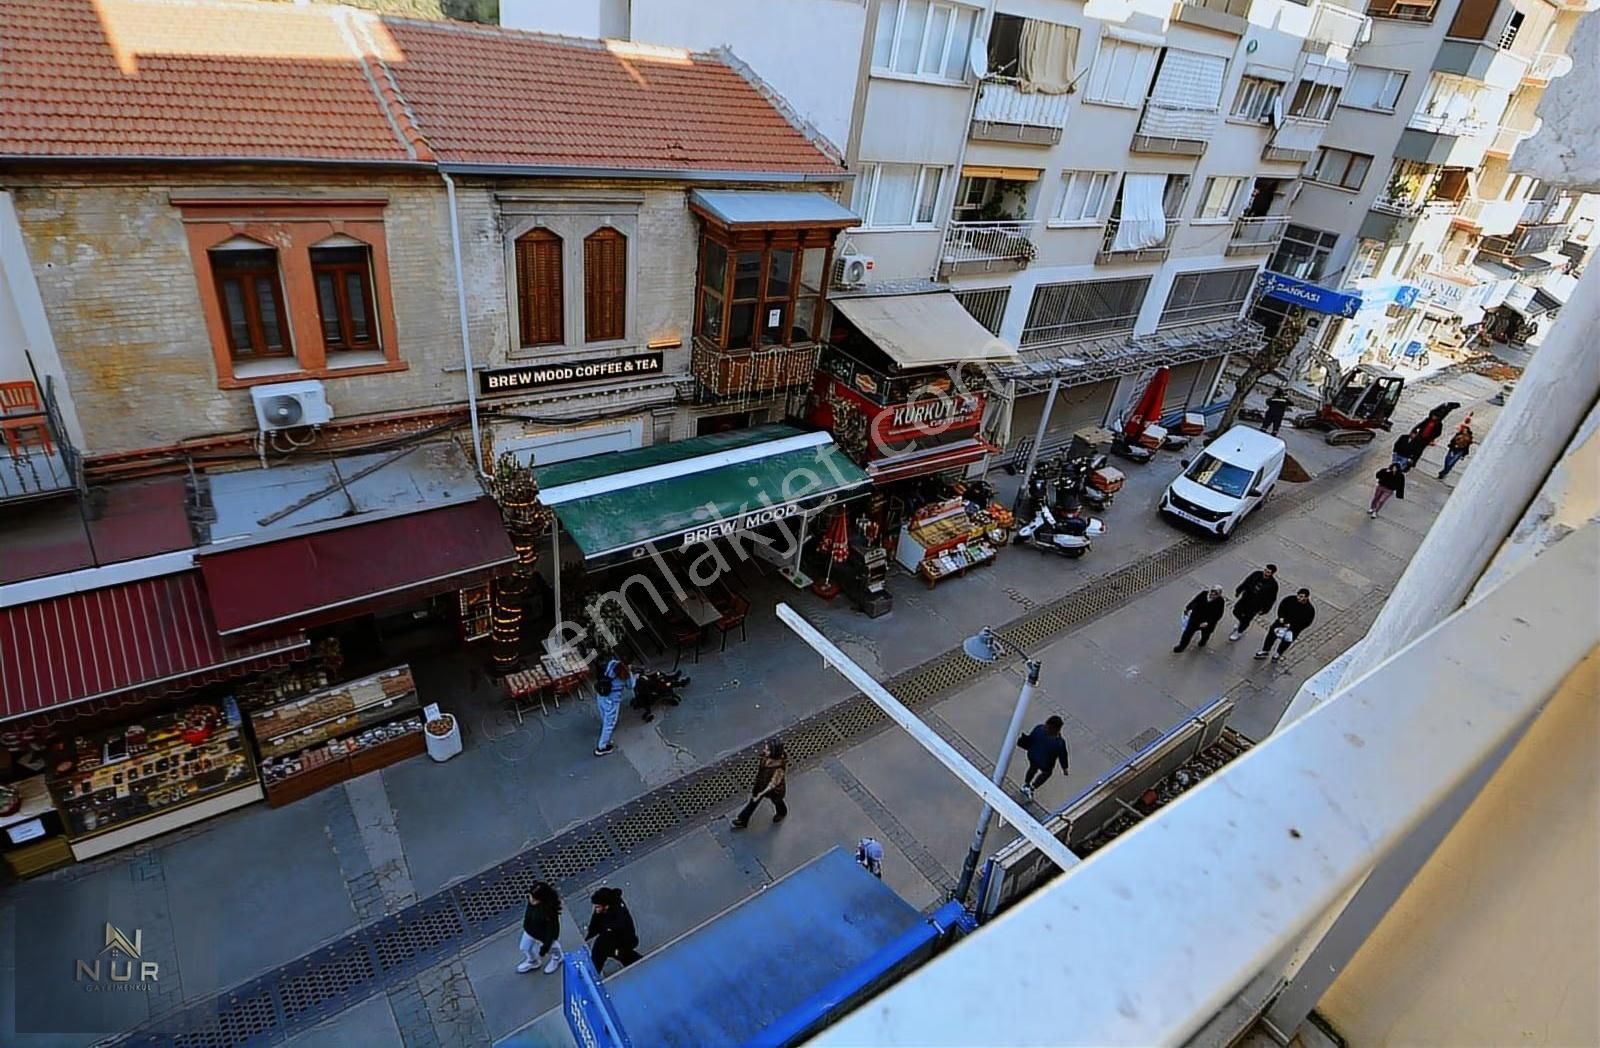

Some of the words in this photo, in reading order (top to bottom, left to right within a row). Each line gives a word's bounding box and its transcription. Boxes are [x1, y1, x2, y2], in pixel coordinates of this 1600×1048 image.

[488, 372, 532, 389] BREW
[534, 367, 574, 383] MOOD
[575, 361, 623, 378] COFFEE
[624, 361, 634, 372] &
[636, 358, 659, 371] TEA
[683, 521, 737, 545] BREW
[745, 504, 798, 529] MOOD
